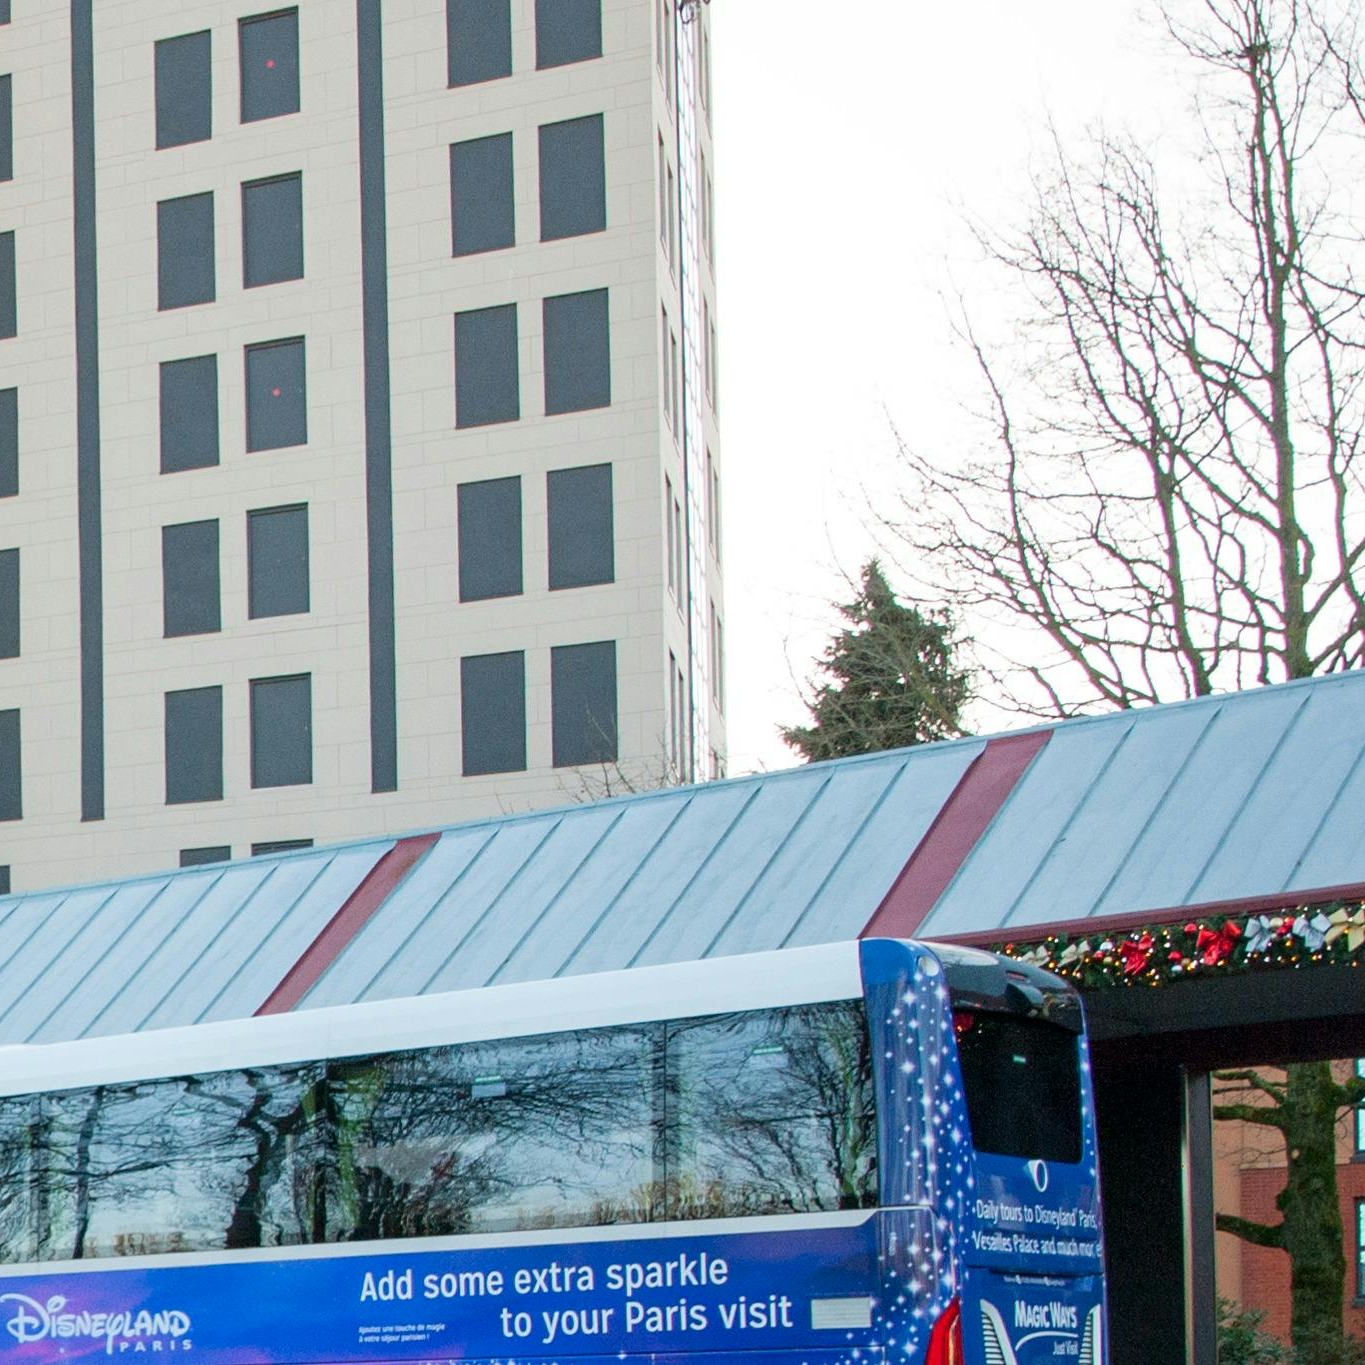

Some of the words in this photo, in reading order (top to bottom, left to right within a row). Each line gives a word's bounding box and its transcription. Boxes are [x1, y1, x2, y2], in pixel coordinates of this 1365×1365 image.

[976, 1199, 998, 1224] Daily
[1000, 1203, 1022, 1222] tours
[1023, 1205, 1033, 1223] to
[1013, 1234, 1040, 1254] Palace
[1041, 1237, 1057, 1255] and
[1057, 1238, 1078, 1257] much
[360, 1269, 413, 1302] Add
[423, 1270, 504, 1298] some
[515, 1262, 594, 1294] extra
[606, 1252, 729, 1297] sparkle
[501, 1306, 533, 1338] to
[542, 1306, 614, 1344] your
[626, 1299, 706, 1332] Paris
[719, 1295, 793, 1331] visit
[120, 1339, 192, 1353] PARIS
